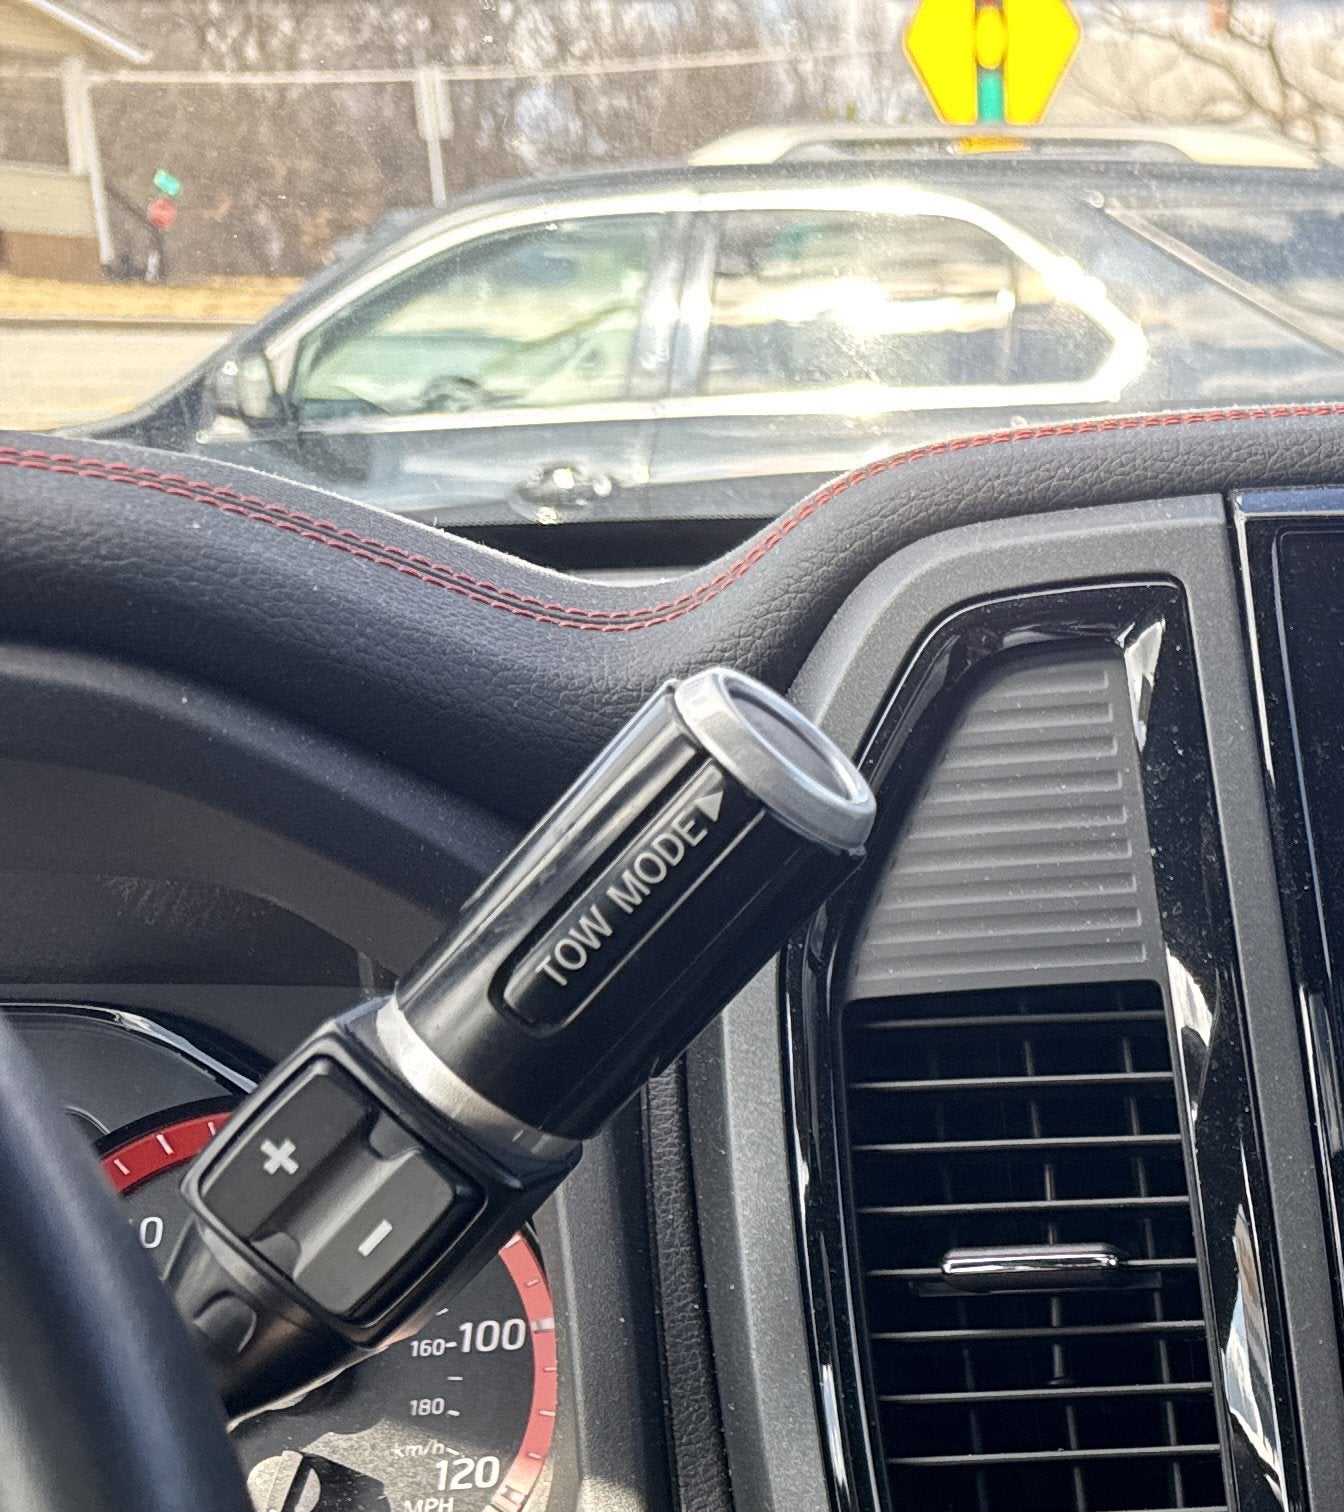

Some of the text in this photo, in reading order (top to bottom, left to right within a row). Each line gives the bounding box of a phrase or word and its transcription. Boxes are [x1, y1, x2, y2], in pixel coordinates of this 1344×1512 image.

[535, 810, 709, 989] TOW MODE
[410, 1319, 526, 1358] 160 100
[409, 1396, 446, 1417] 180
[390, 1437, 446, 1458] km/h
[435, 1455, 501, 1491] 120
